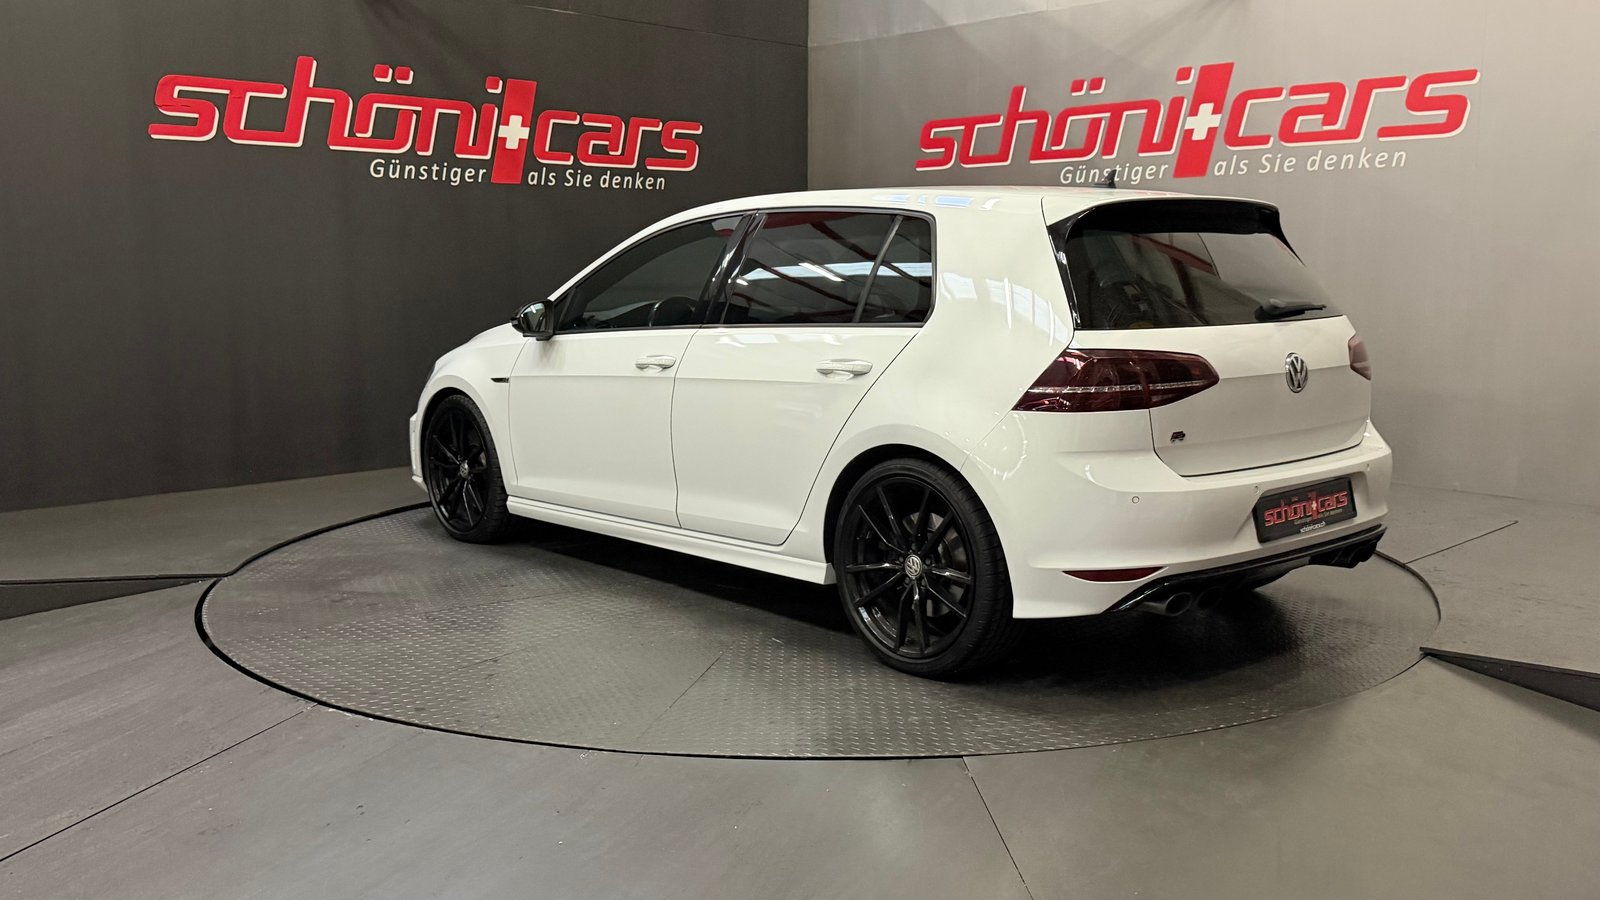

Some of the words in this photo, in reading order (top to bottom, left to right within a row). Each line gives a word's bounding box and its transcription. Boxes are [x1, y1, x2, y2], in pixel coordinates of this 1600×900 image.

[369, 158, 487, 186] Günstiger
[527, 167, 557, 187] als
[564, 168, 593, 188] Sie
[599, 170, 666, 191] denken
[1213, 157, 1249, 177] als
[1258, 153, 1296, 174] Sie
[1305, 148, 1407, 172] denken
